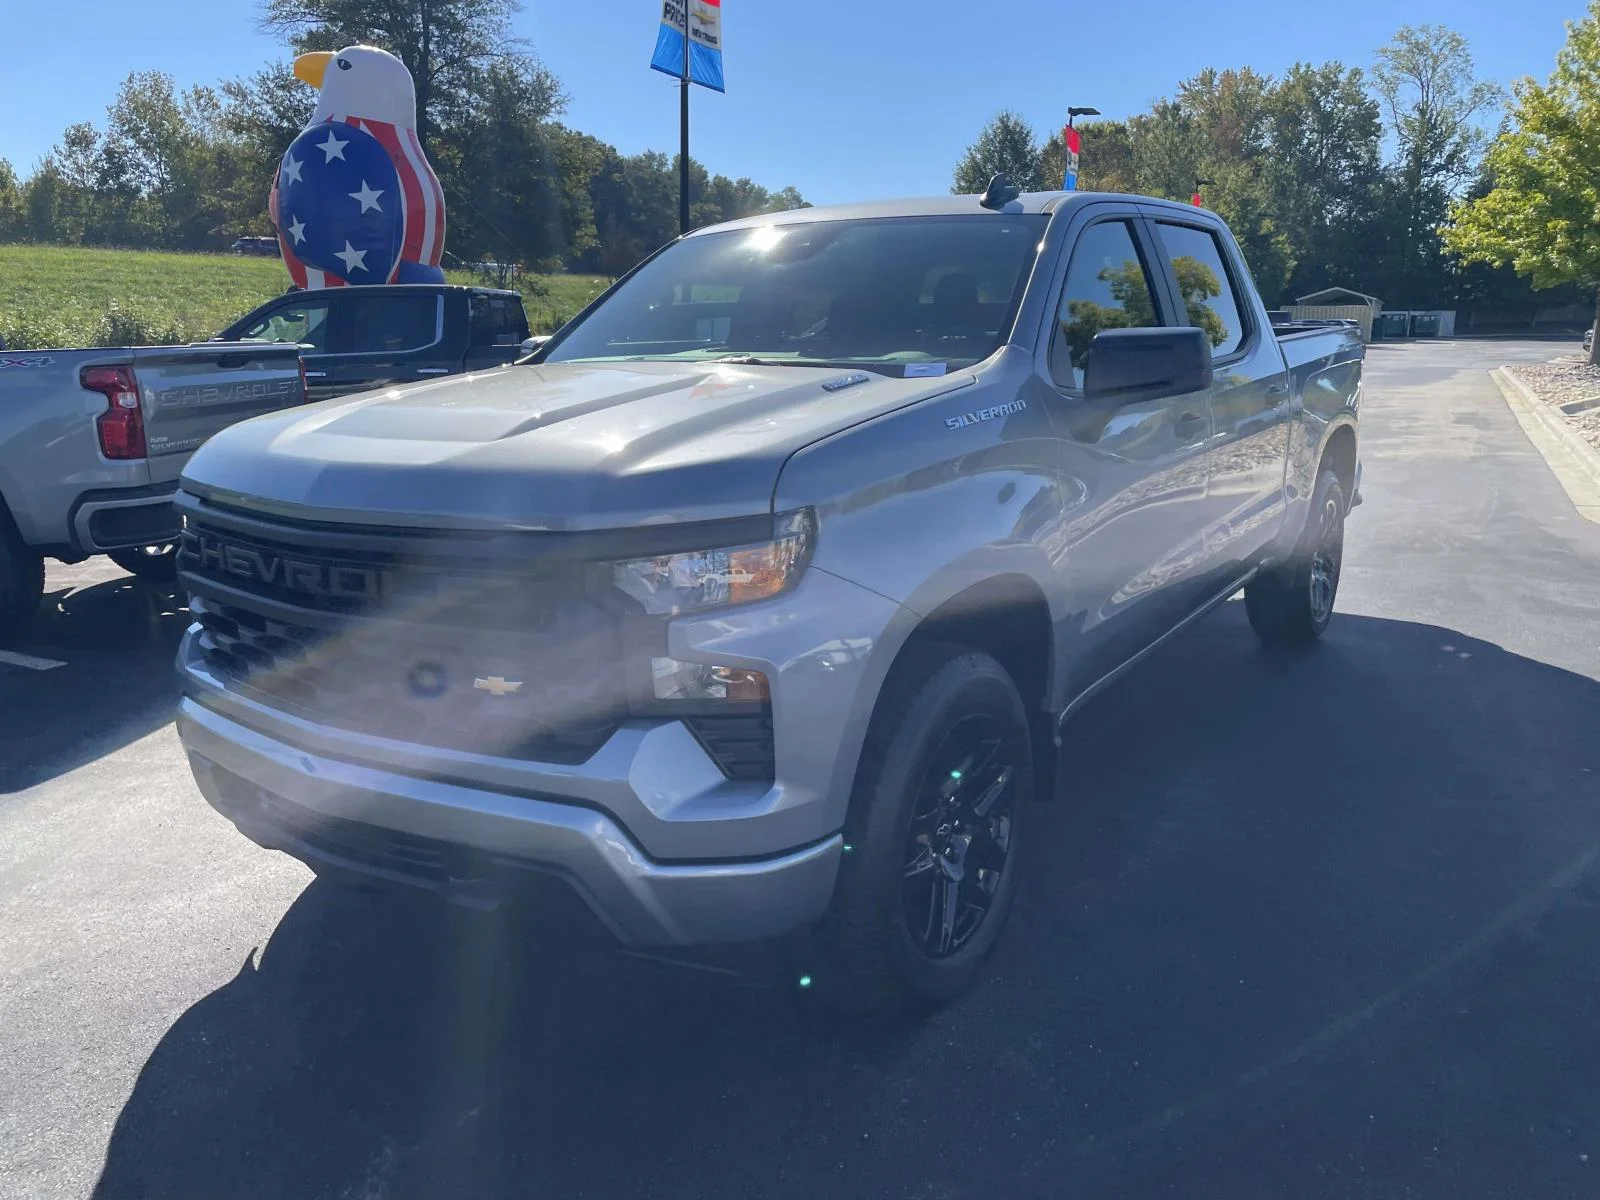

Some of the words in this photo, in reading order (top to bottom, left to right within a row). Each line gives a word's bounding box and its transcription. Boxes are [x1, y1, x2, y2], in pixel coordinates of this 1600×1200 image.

[0, 356, 56, 369] X4
[159, 379, 299, 406] CHEVROLET
[945, 399, 1027, 431] SILVERADO
